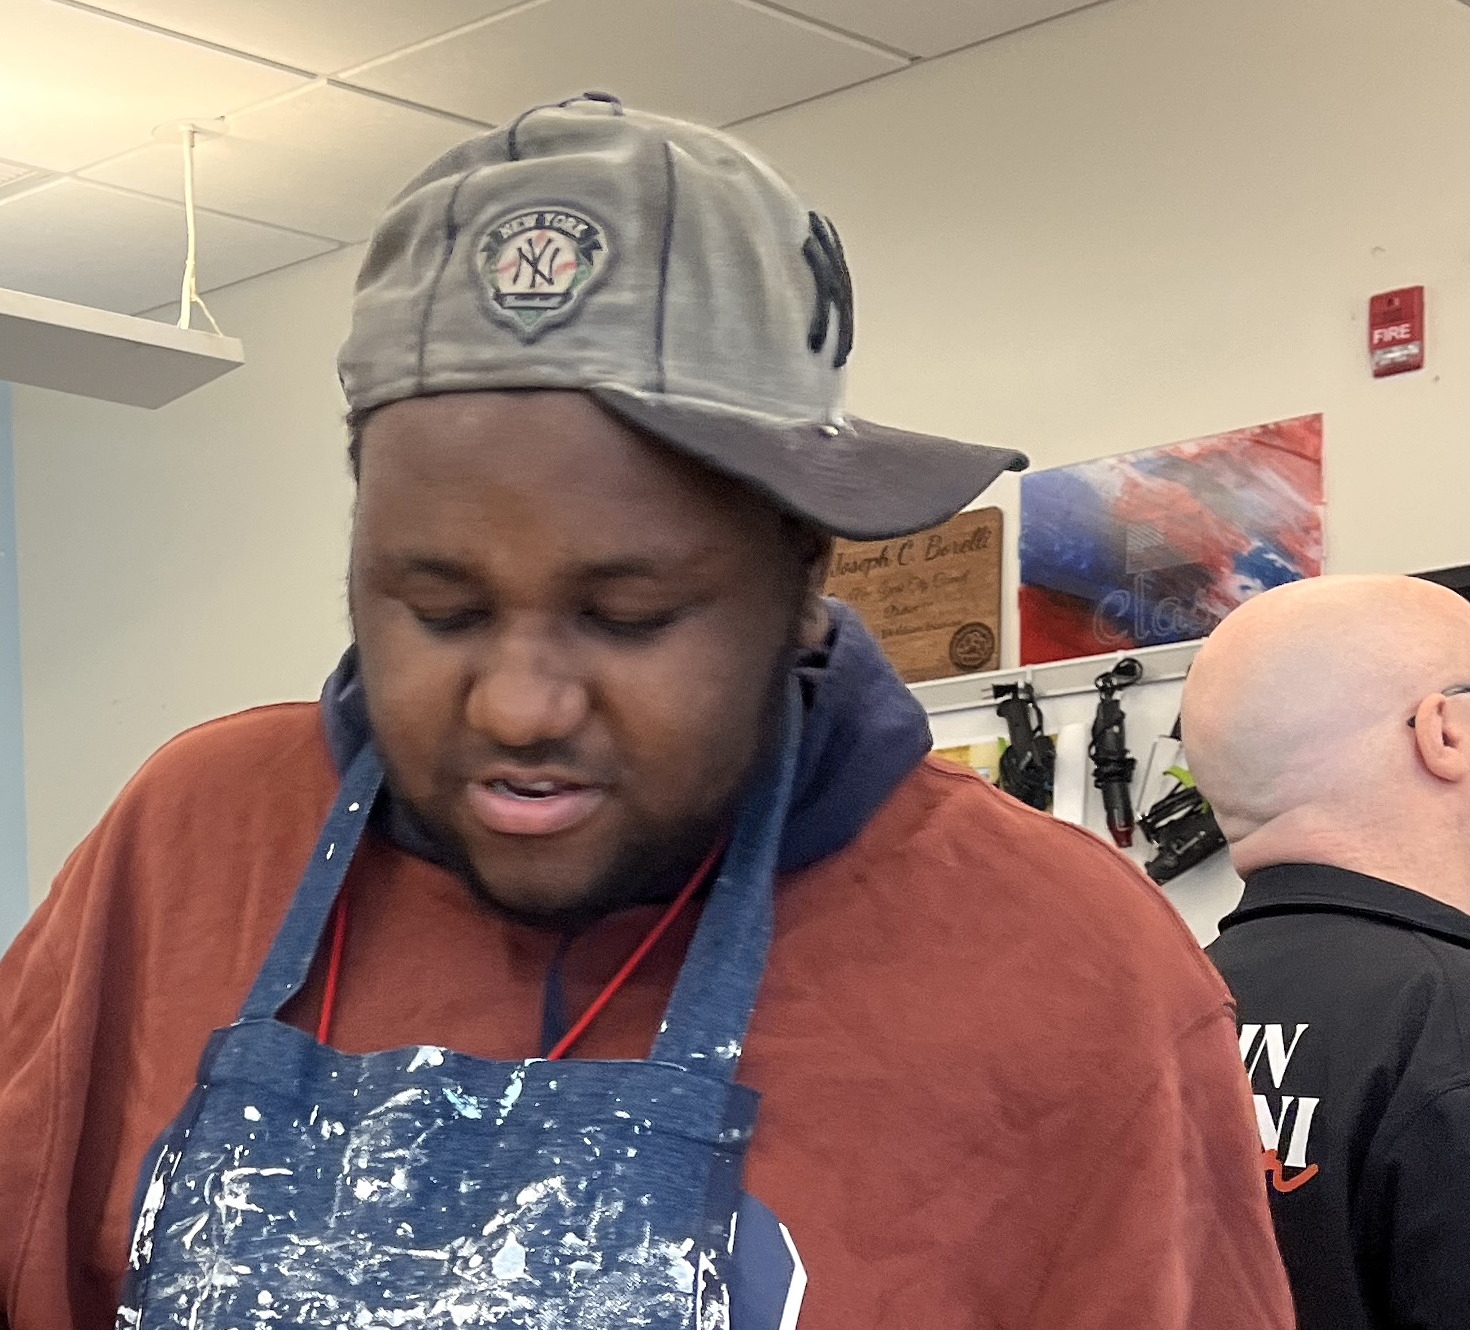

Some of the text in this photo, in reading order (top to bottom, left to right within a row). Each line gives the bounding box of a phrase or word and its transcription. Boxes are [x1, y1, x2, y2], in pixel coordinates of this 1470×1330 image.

[499, 213, 589, 239] NEW YORK
[512, 238, 561, 288] NY
[1372, 322, 1411, 345] FIRE
